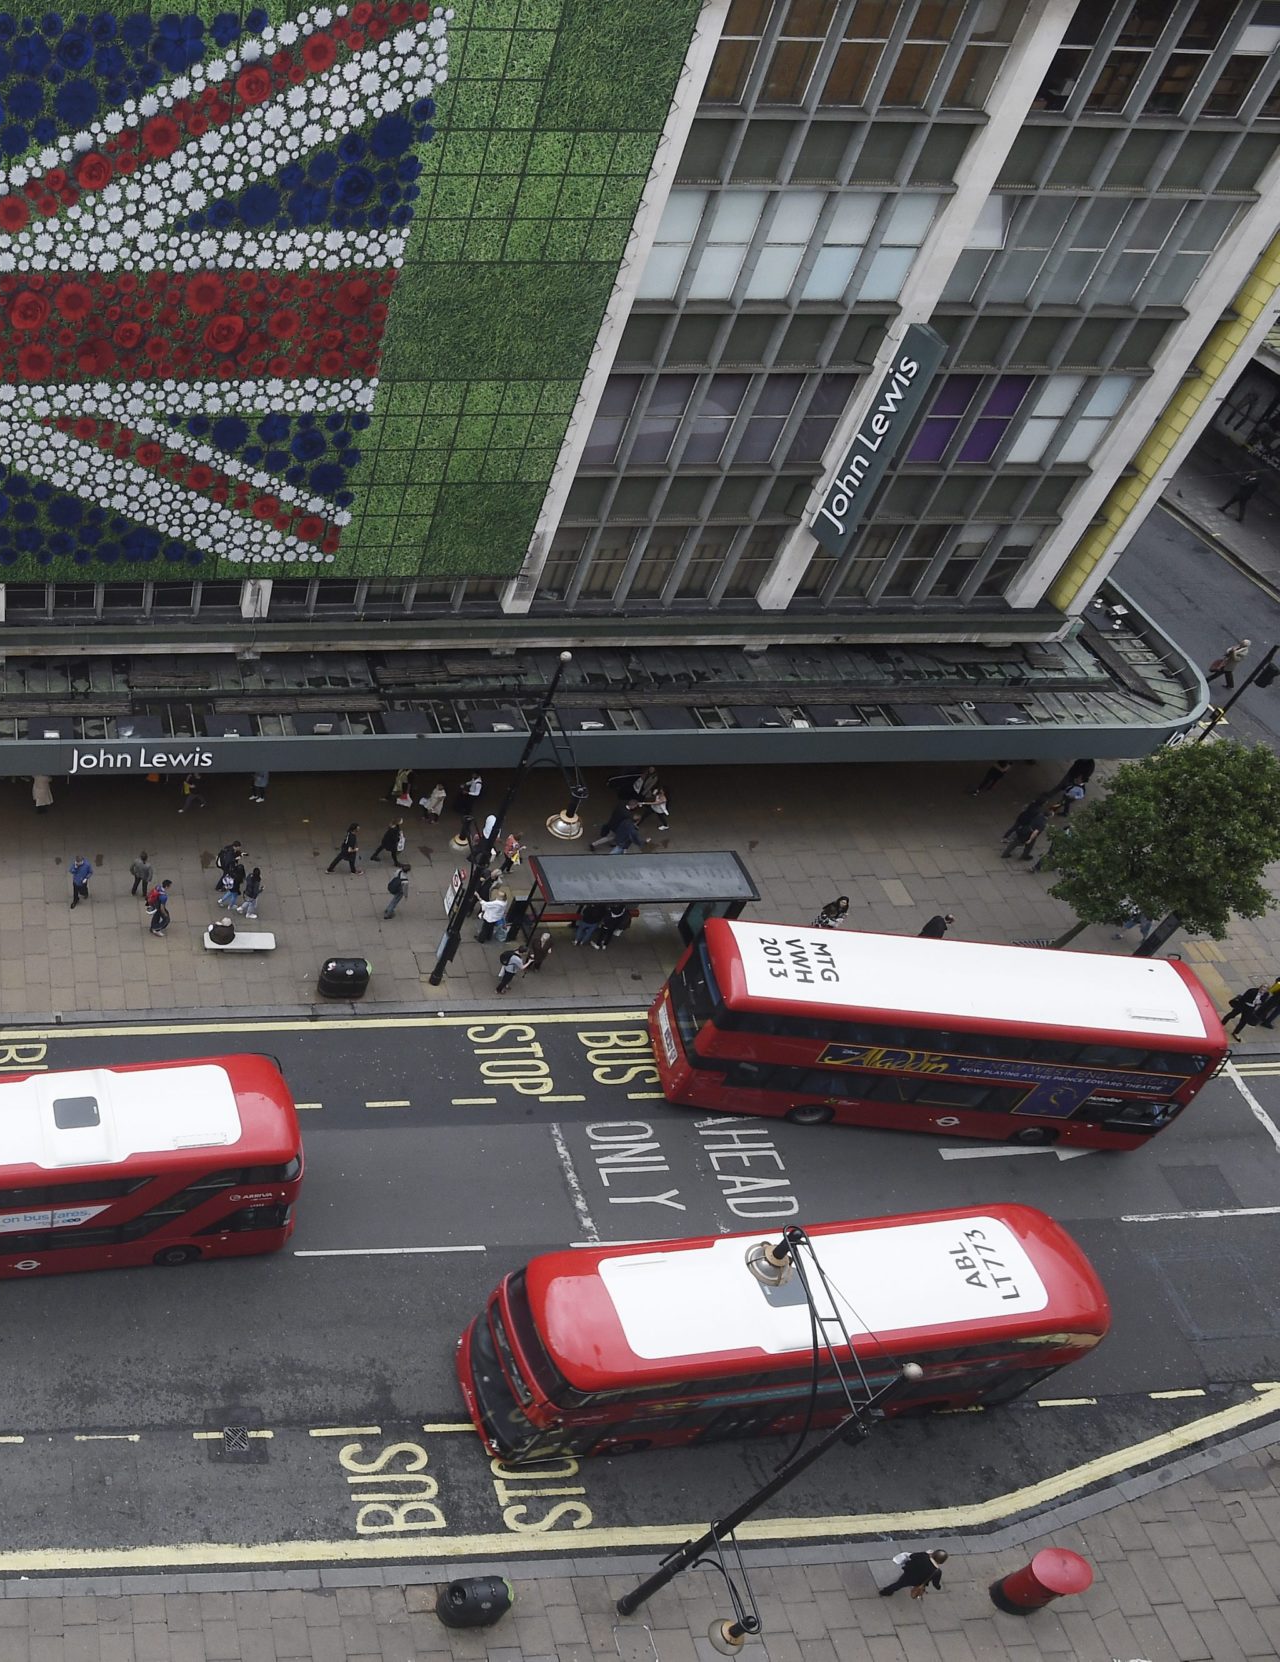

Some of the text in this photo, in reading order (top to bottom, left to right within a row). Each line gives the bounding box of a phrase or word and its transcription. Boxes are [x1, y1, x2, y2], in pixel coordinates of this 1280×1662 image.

[821, 355, 920, 535] John Lewis
[69, 746, 213, 774] John Lewis
[759, 937, 789, 978] 2013
[785, 938, 815, 984] VWH
[810, 942, 840, 983] MTG
[467, 1024, 554, 1095] STOP
[577, 1029, 661, 1085] BUS
[824, 1049, 949, 1074] Aladdin
[984, 1069, 1019, 1077] PLAYING
[1124, 1083, 1163, 1091] THEATRE
[585, 1120, 687, 1211] ONLY
[2, 1215, 20, 1224] on
[24, 1213, 50, 1223] bus
[949, 1241, 988, 1288] ABL
[963, 1229, 1020, 1300] LT773
[338, 1442, 448, 1534] BUS
[488, 1449, 593, 1532] STO
